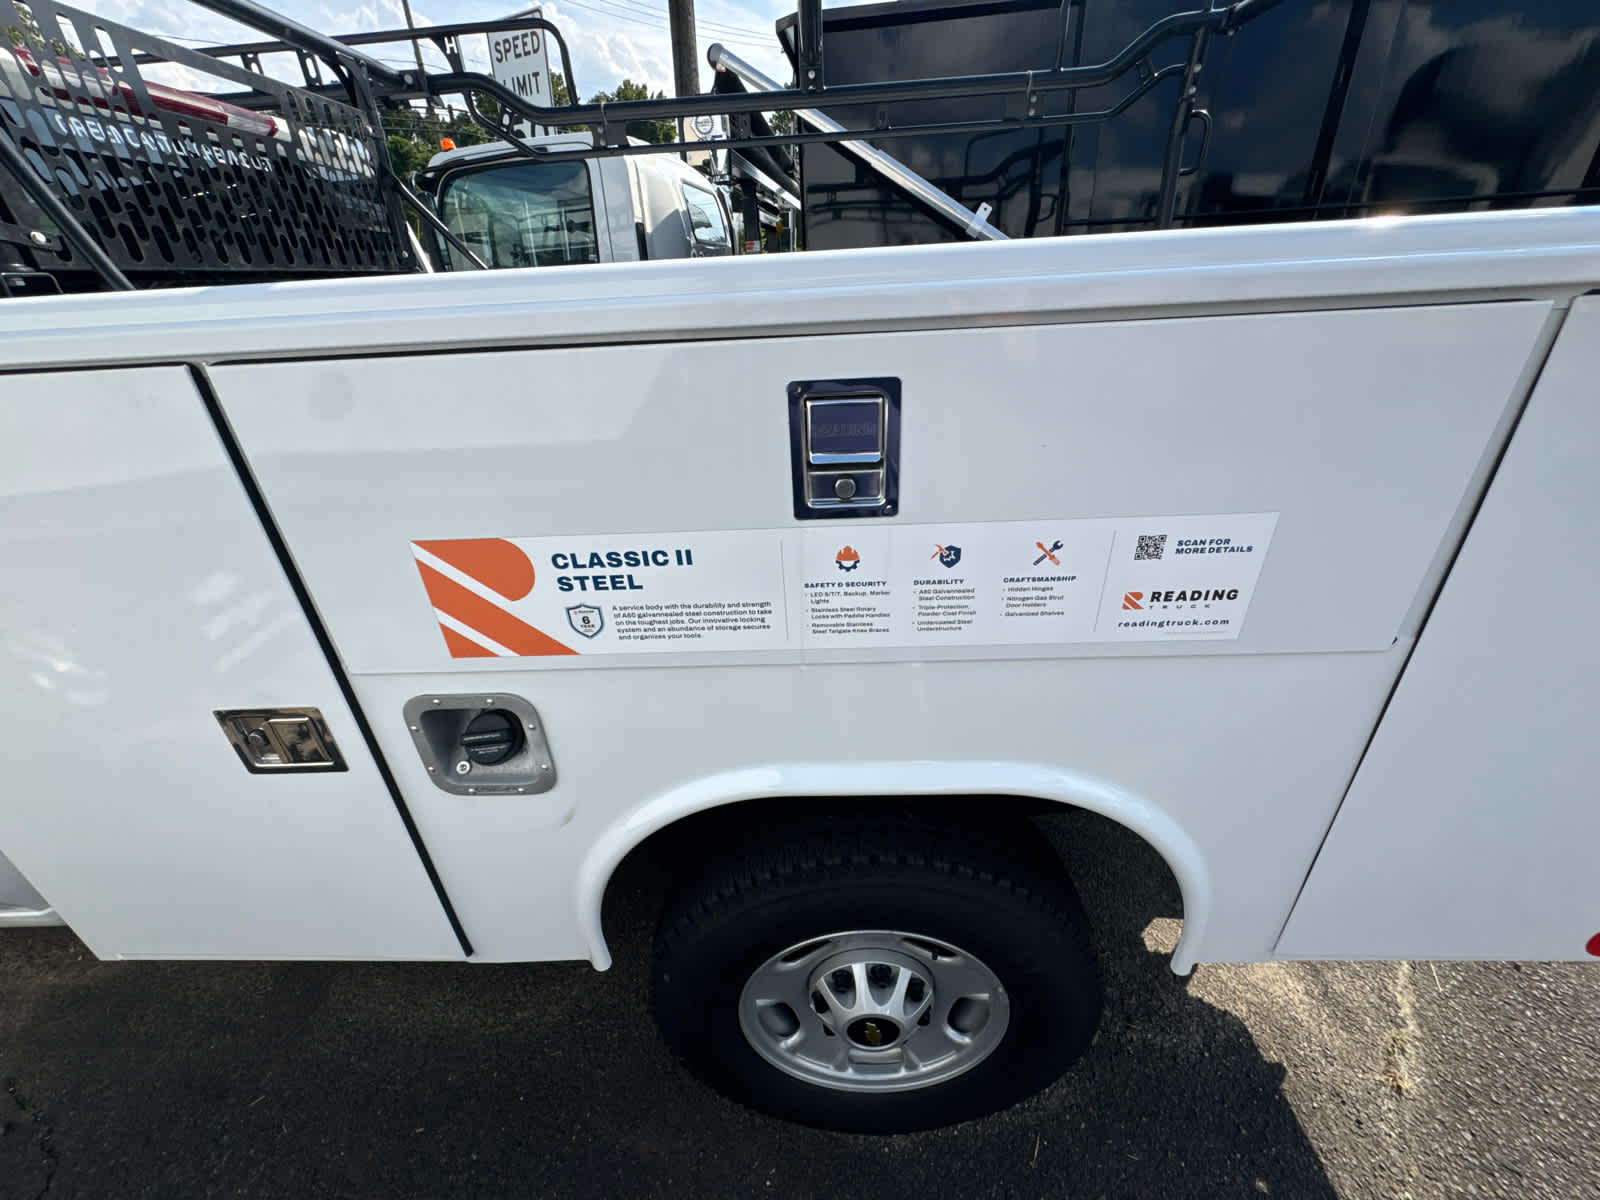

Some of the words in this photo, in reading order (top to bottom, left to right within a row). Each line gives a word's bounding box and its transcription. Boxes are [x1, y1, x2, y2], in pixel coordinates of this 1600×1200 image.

[494, 30, 540, 63] SPEED
[503, 72, 540, 97] IMIT
[1177, 539, 1207, 547] SCAN
[1208, 538, 1231, 546] FOR
[1175, 547, 1207, 555] MORE
[1207, 545, 1253, 554] DETAILS
[551, 550, 669, 570] CLASSIC
[675, 549, 693, 566] II
[556, 574, 644, 592] STEEL
[913, 578, 964, 586] DURABILITY
[1150, 589, 1239, 602] READING
[582, 616, 591, 625] 6
[1118, 619, 1230, 629] readingtruck.com
